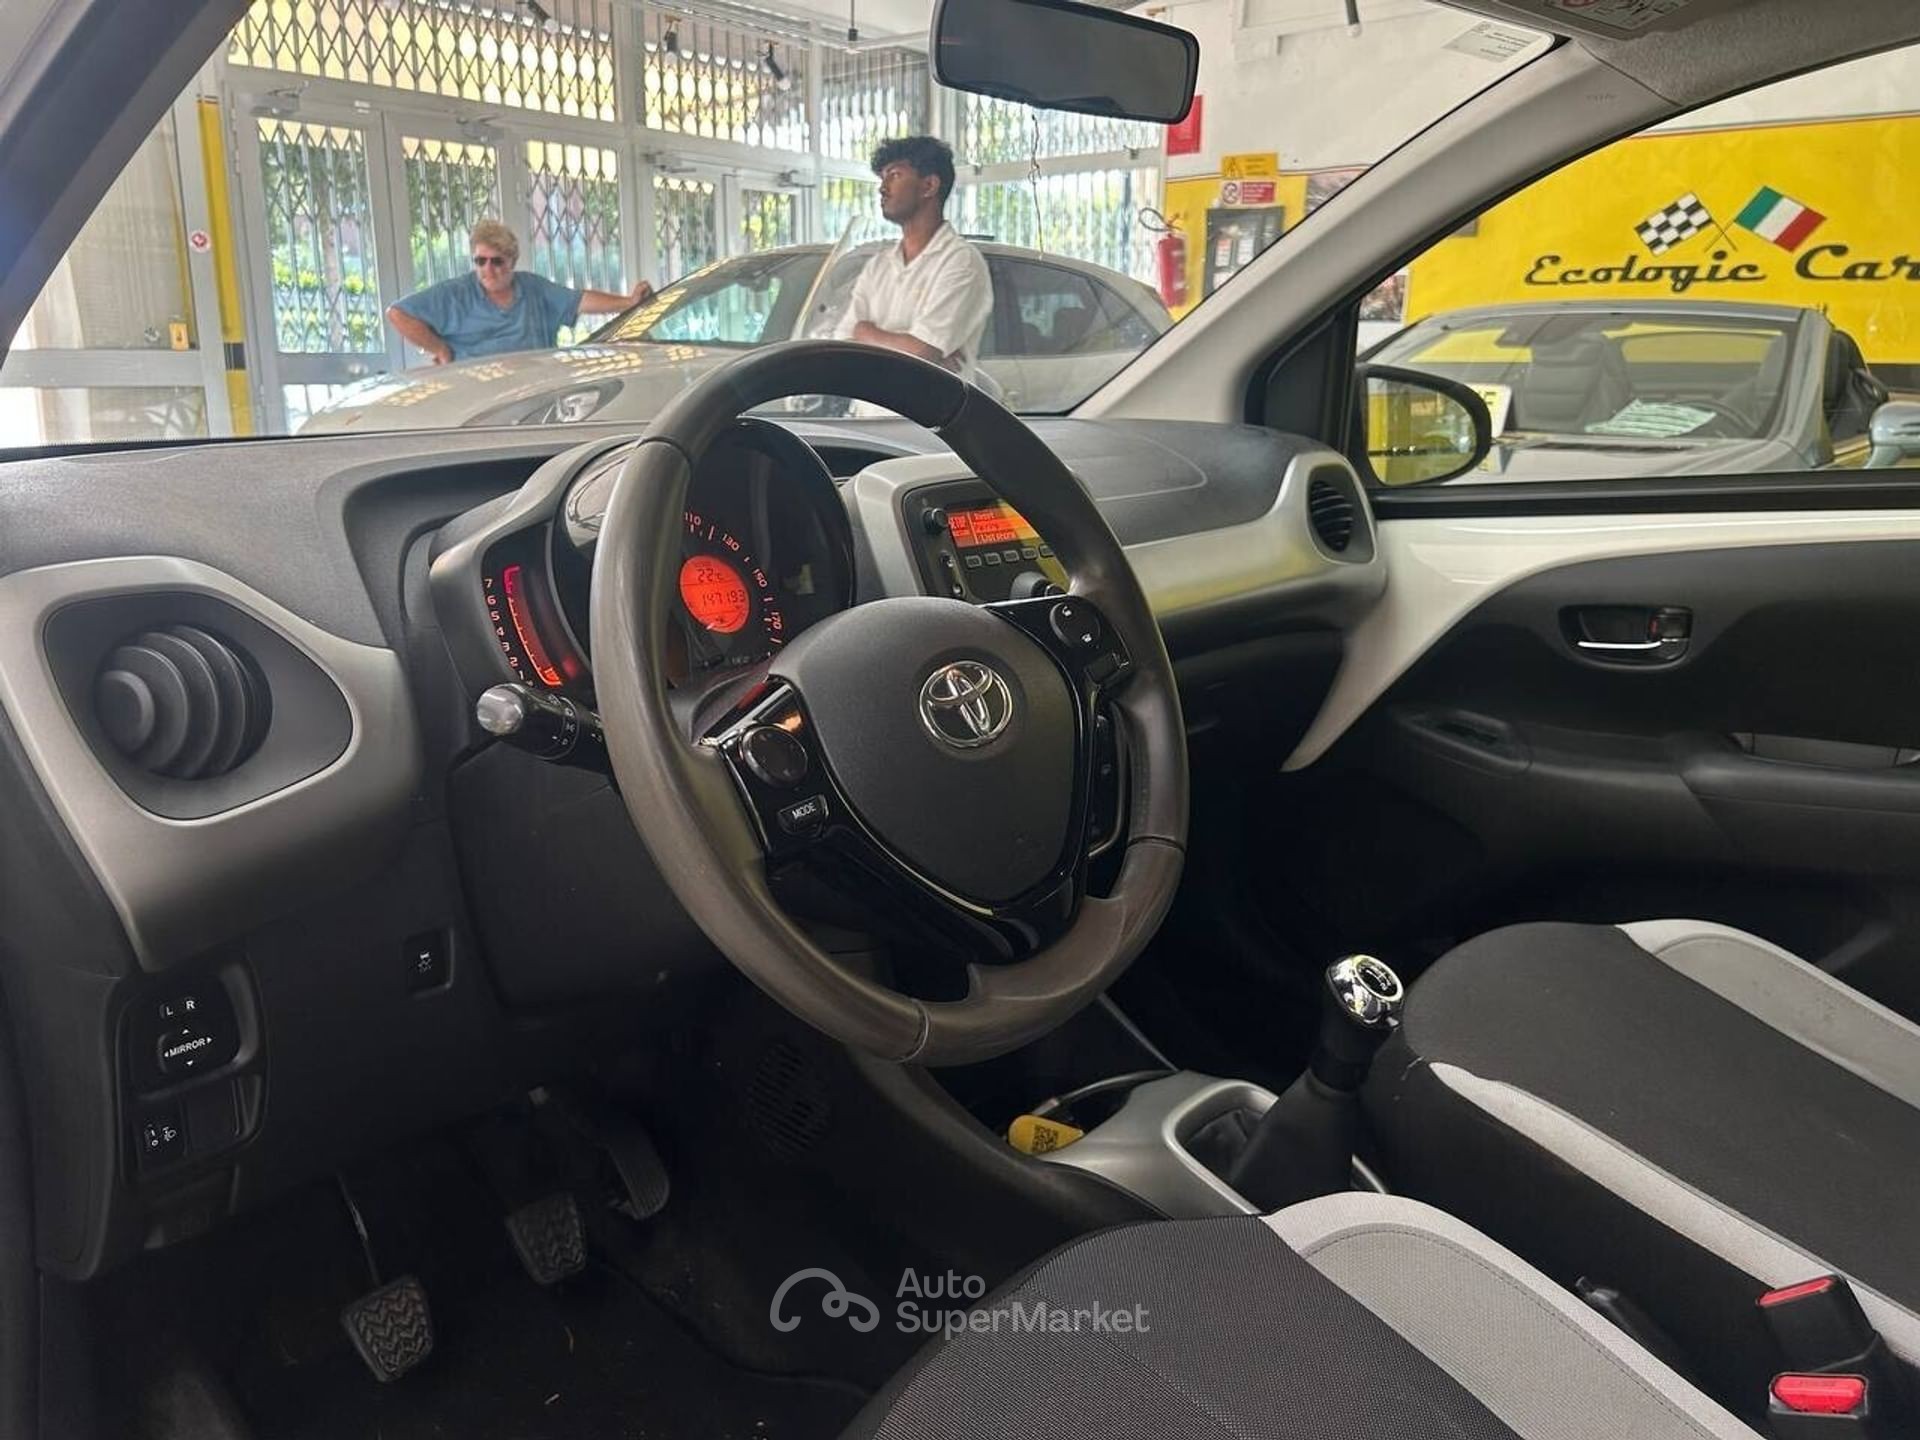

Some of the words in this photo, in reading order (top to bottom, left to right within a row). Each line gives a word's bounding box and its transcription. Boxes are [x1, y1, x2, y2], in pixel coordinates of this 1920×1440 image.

[1524, 250, 1766, 292] Ecologic
[721, 532, 741, 552] 130
[484, 578, 493, 588] 7
[752, 567, 769, 589] 150
[487, 595, 496, 605] 6
[491, 611, 500, 621] 5
[509, 656, 518, 668] 2
[791, 802, 817, 820] MODE
[166, 1006, 174, 1016] L
[185, 1000, 196, 1010] R
[169, 1037, 206, 1057] MIRROR
